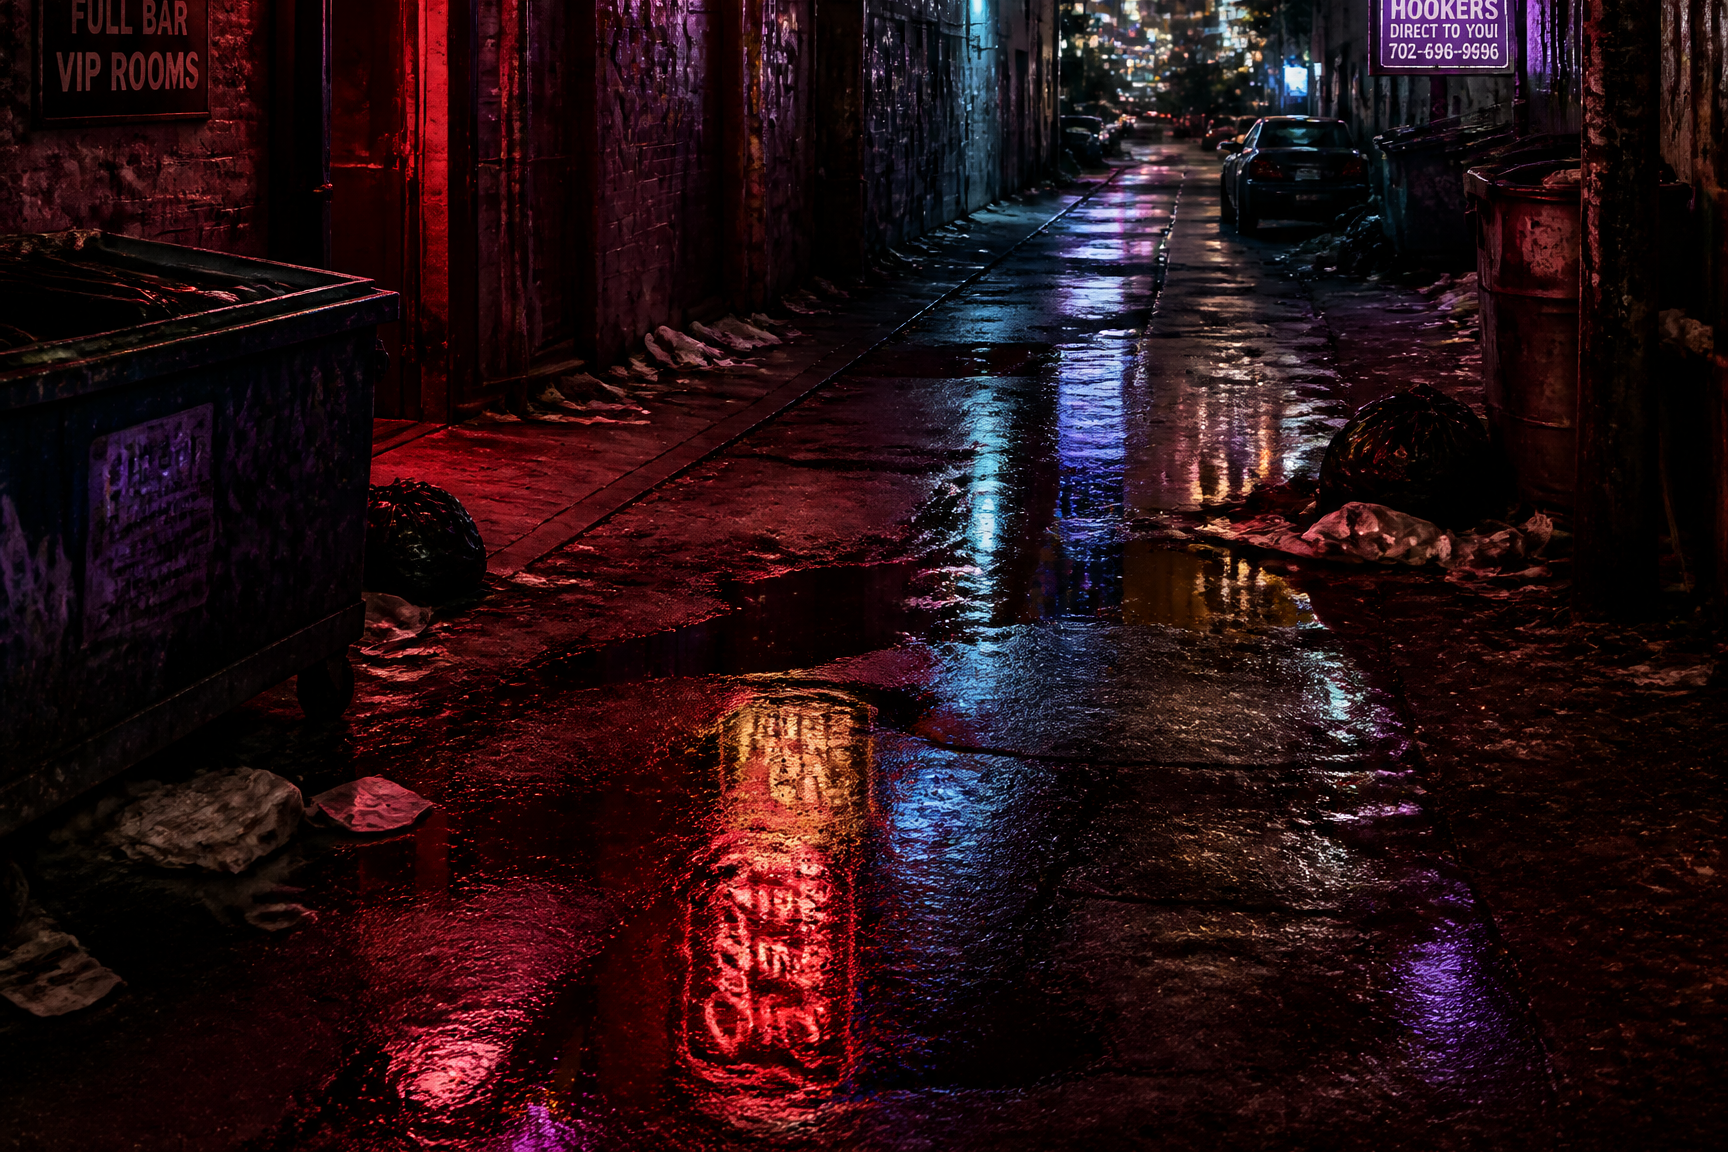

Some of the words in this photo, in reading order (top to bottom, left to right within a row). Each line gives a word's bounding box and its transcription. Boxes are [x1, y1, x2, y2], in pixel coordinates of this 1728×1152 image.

[1390, 23, 1438, 38] DIRECT
[1442, 23, 1460, 38] TO
[56, 51, 101, 92] VIP
[111, 51, 199, 91] ROOMS
